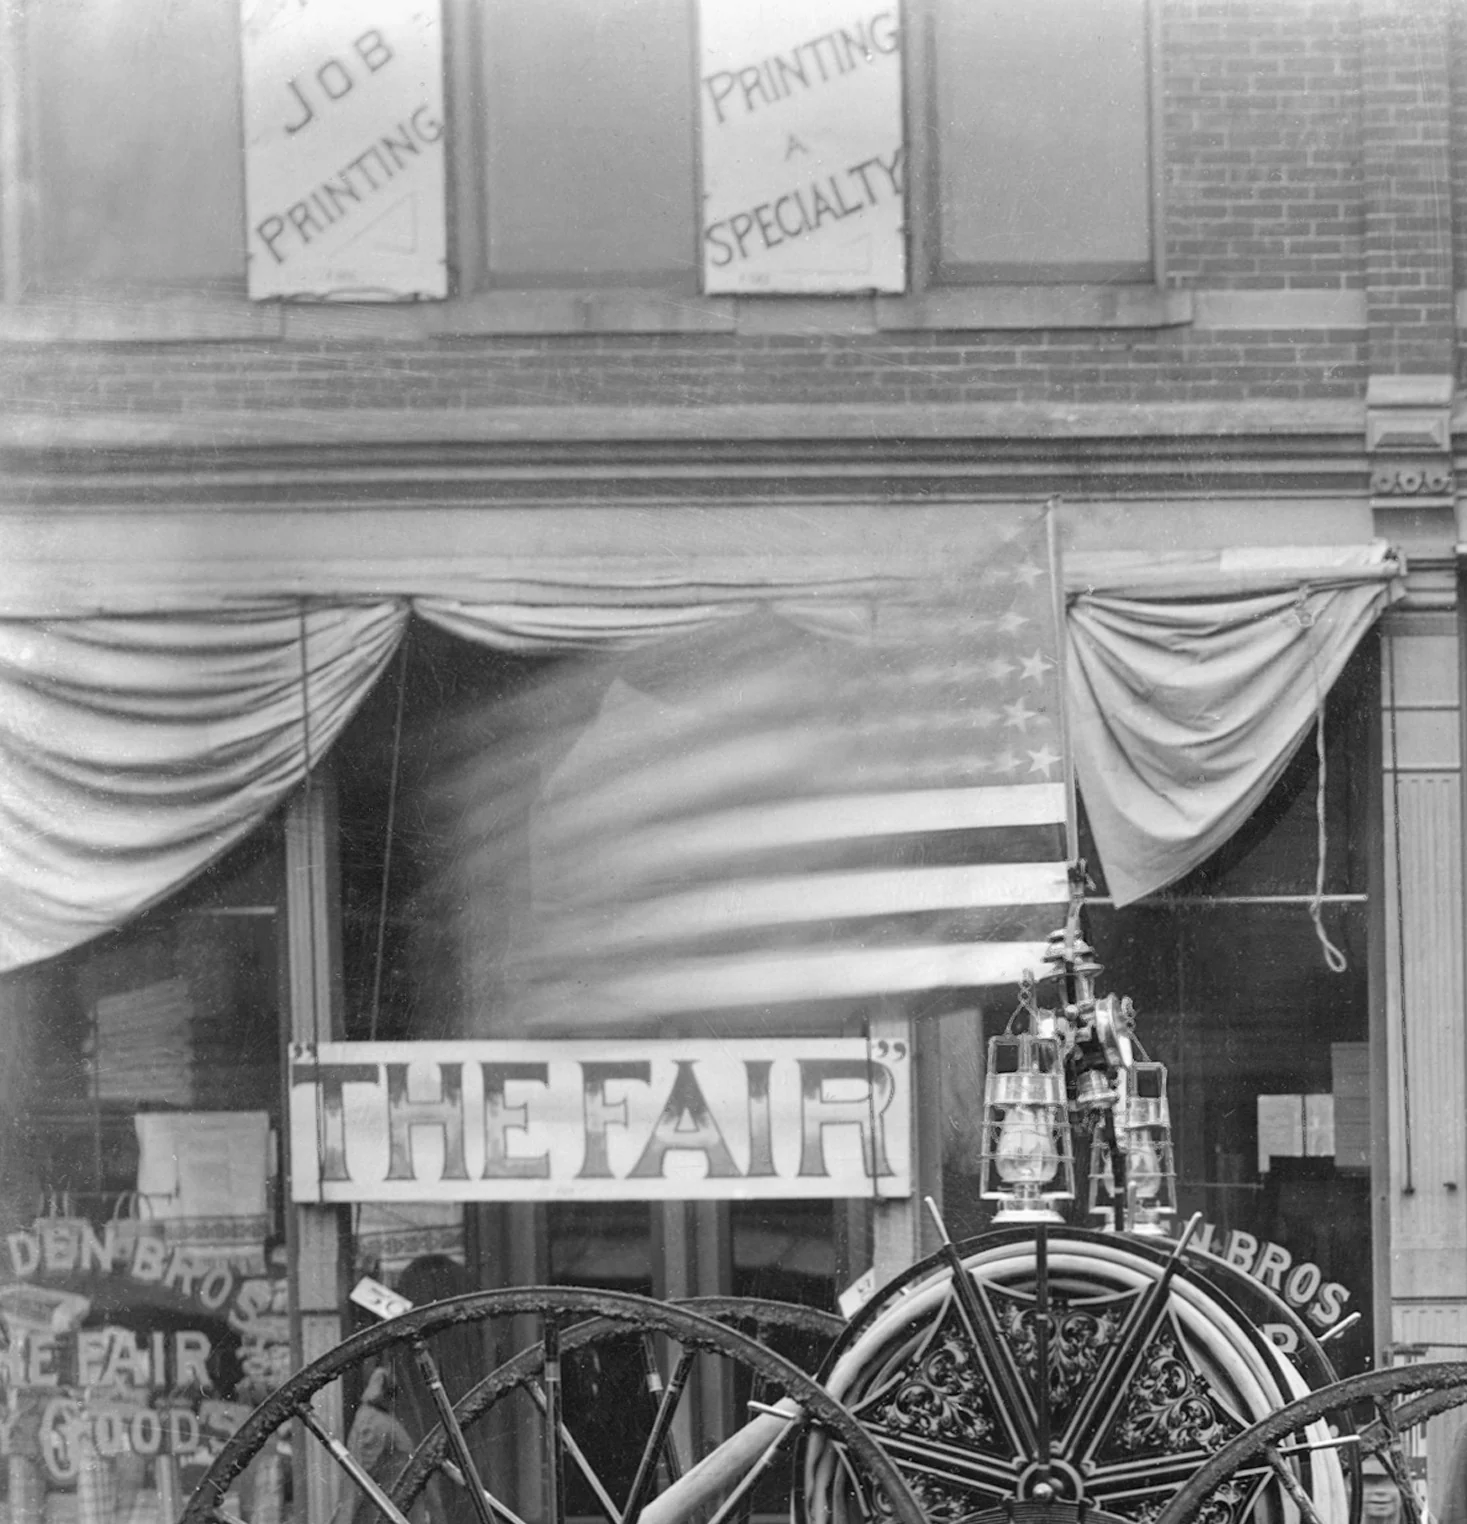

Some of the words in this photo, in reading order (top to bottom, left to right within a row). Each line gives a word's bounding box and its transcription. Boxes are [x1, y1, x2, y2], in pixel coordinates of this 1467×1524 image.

[285, 30, 393, 134] JOB
[702, 13, 899, 123] PRINTING
[256, 105, 444, 264] PRINTING
[705, 147, 902, 267] SPECIALTY
